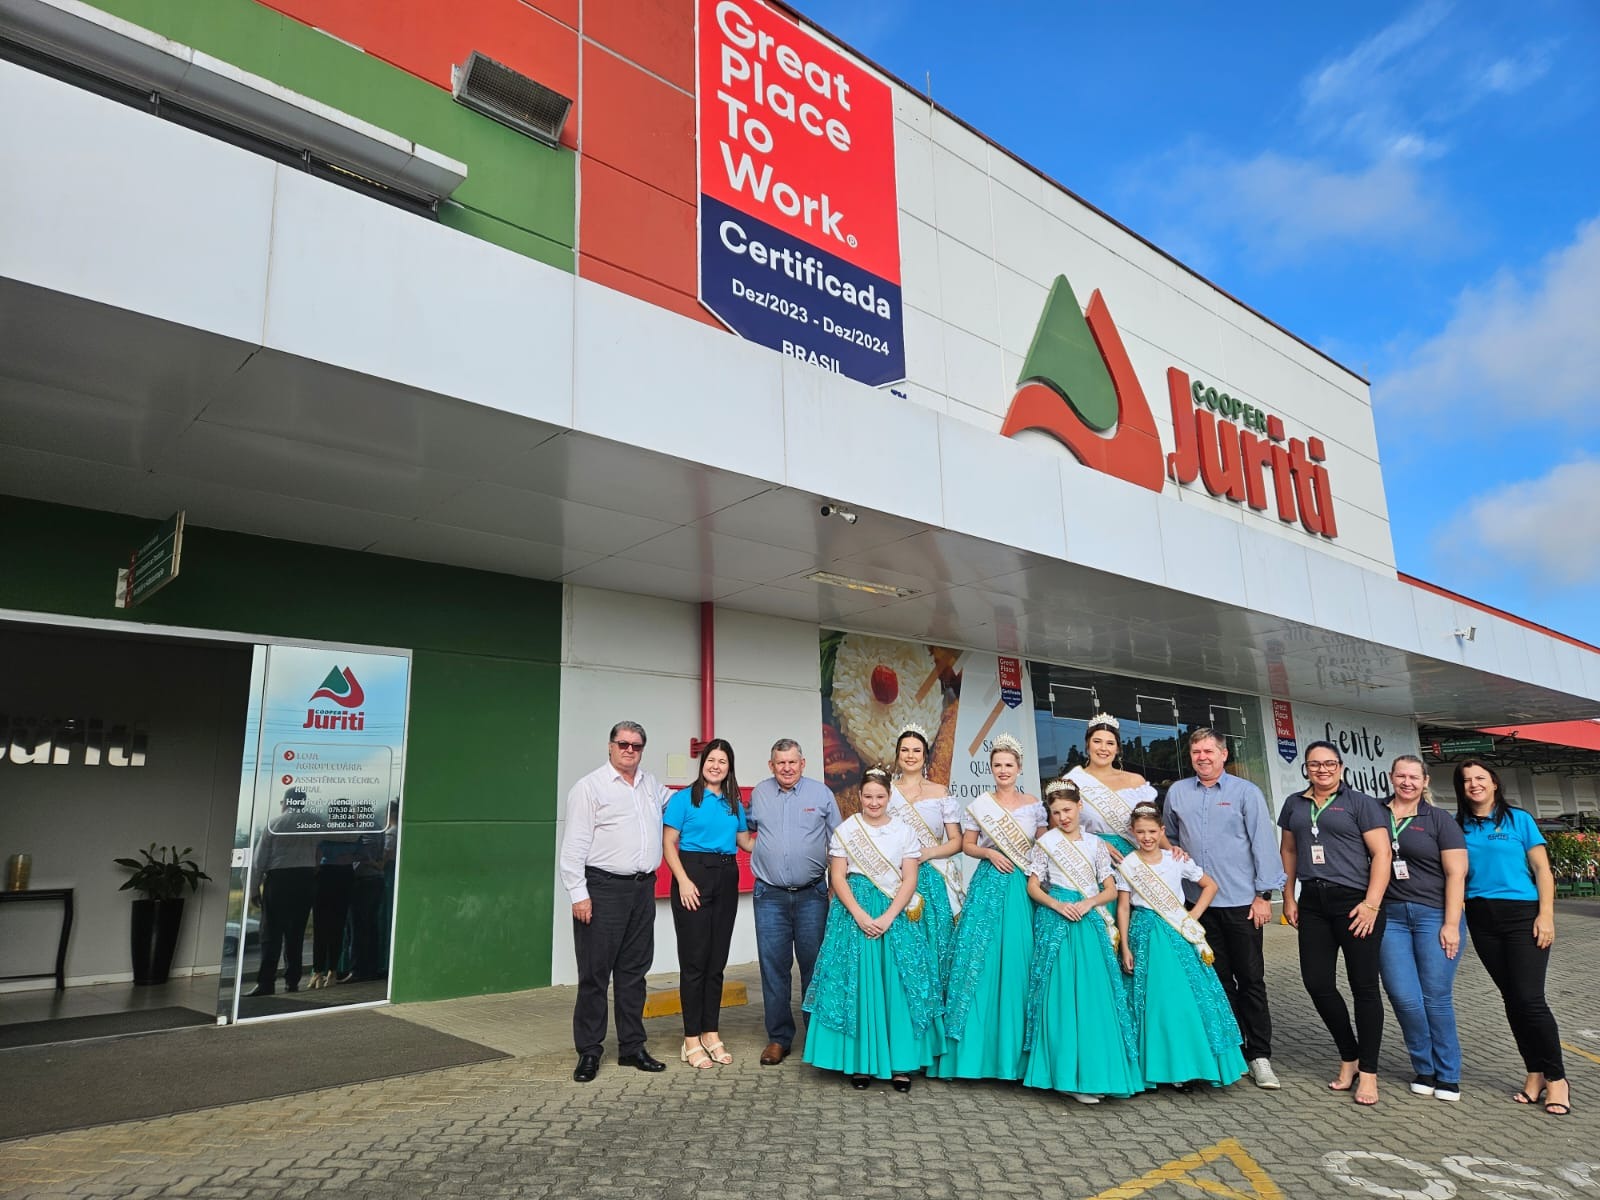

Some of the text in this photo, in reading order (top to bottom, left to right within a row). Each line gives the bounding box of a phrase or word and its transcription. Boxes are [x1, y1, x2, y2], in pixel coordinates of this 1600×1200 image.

[716, 1, 850, 111] Great
[717, 89, 773, 154] To
[721, 43, 851, 152] Place
[719, 220, 891, 319] Certificada
[732, 278, 808, 323] Dez/2023
[823, 316, 890, 356] Dez/2024
[782, 339, 846, 376] BRASIL
[1191, 380, 1267, 432] COOPER
[1167, 366, 1338, 538] Juriti
[303, 709, 364, 731] Juriti
[1325, 722, 1384, 761] Gente
